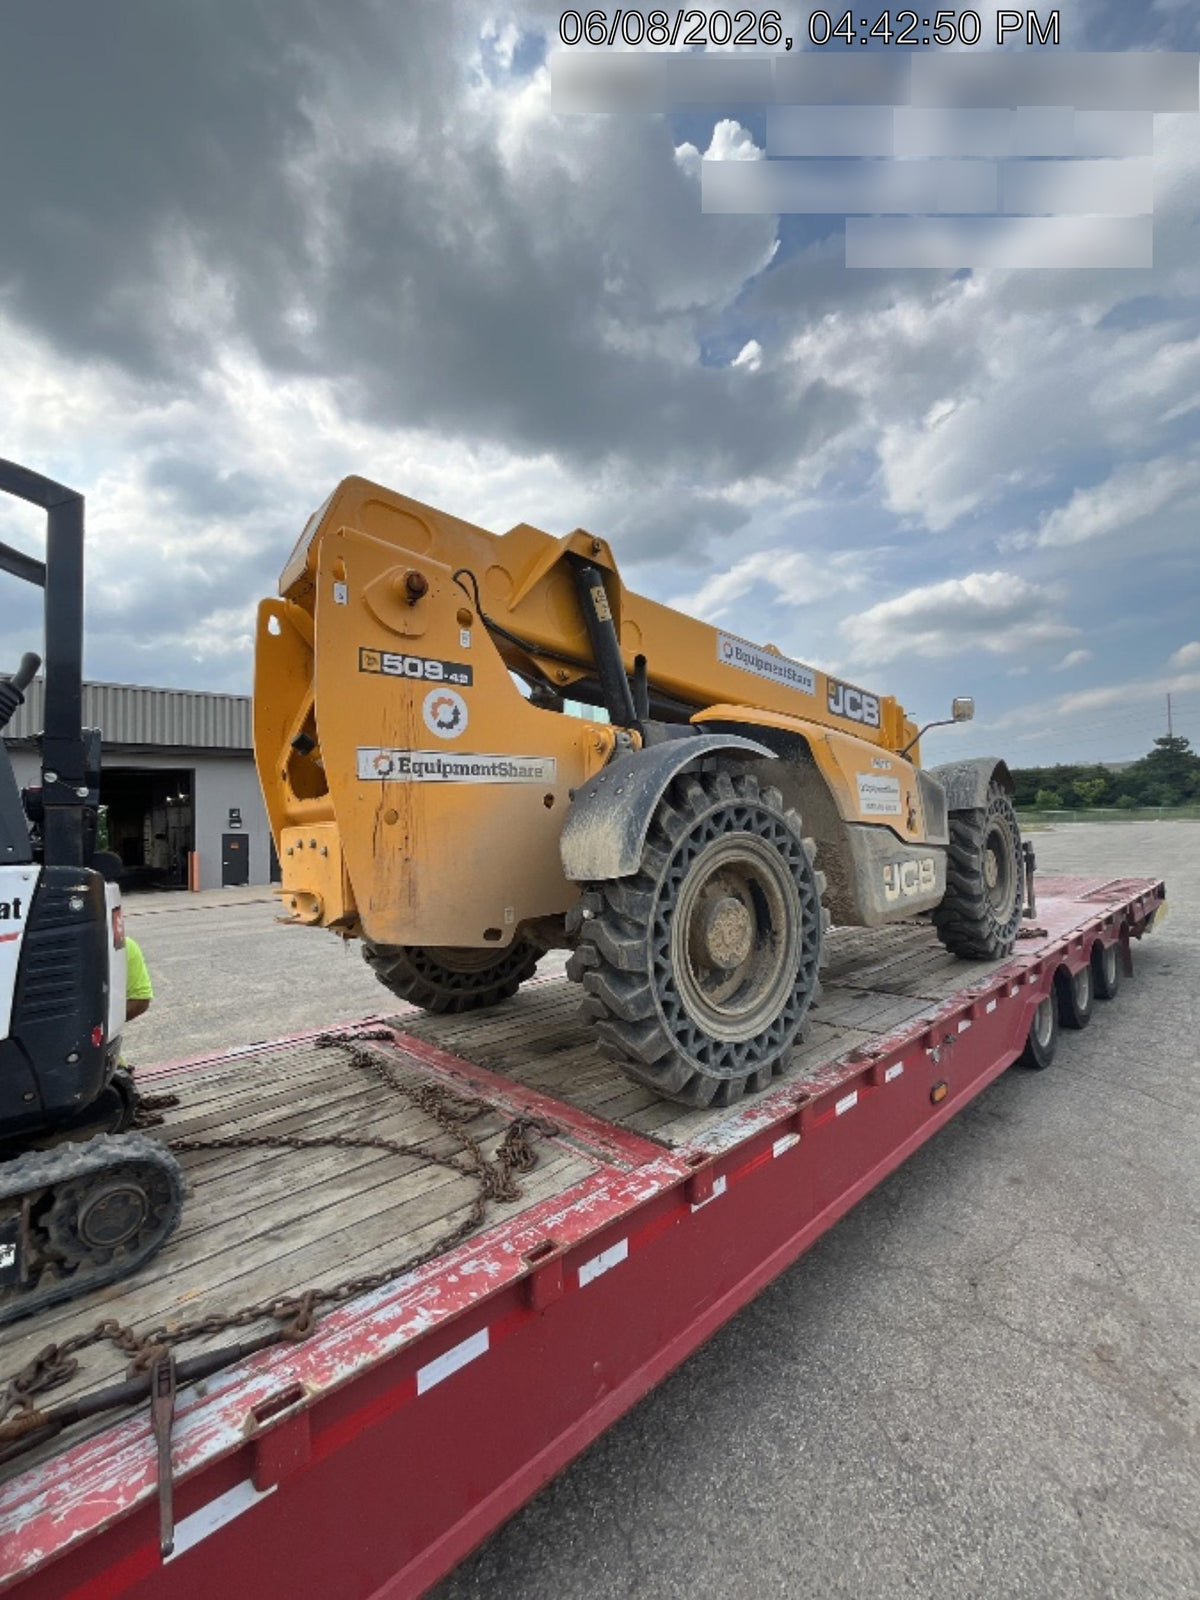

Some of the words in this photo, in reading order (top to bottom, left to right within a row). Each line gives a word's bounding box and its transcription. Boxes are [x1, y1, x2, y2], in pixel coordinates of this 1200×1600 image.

[829, 683, 880, 726] JCB
[398, 757, 544, 778] EquipmentShare
[883, 858, 936, 899] JCB
